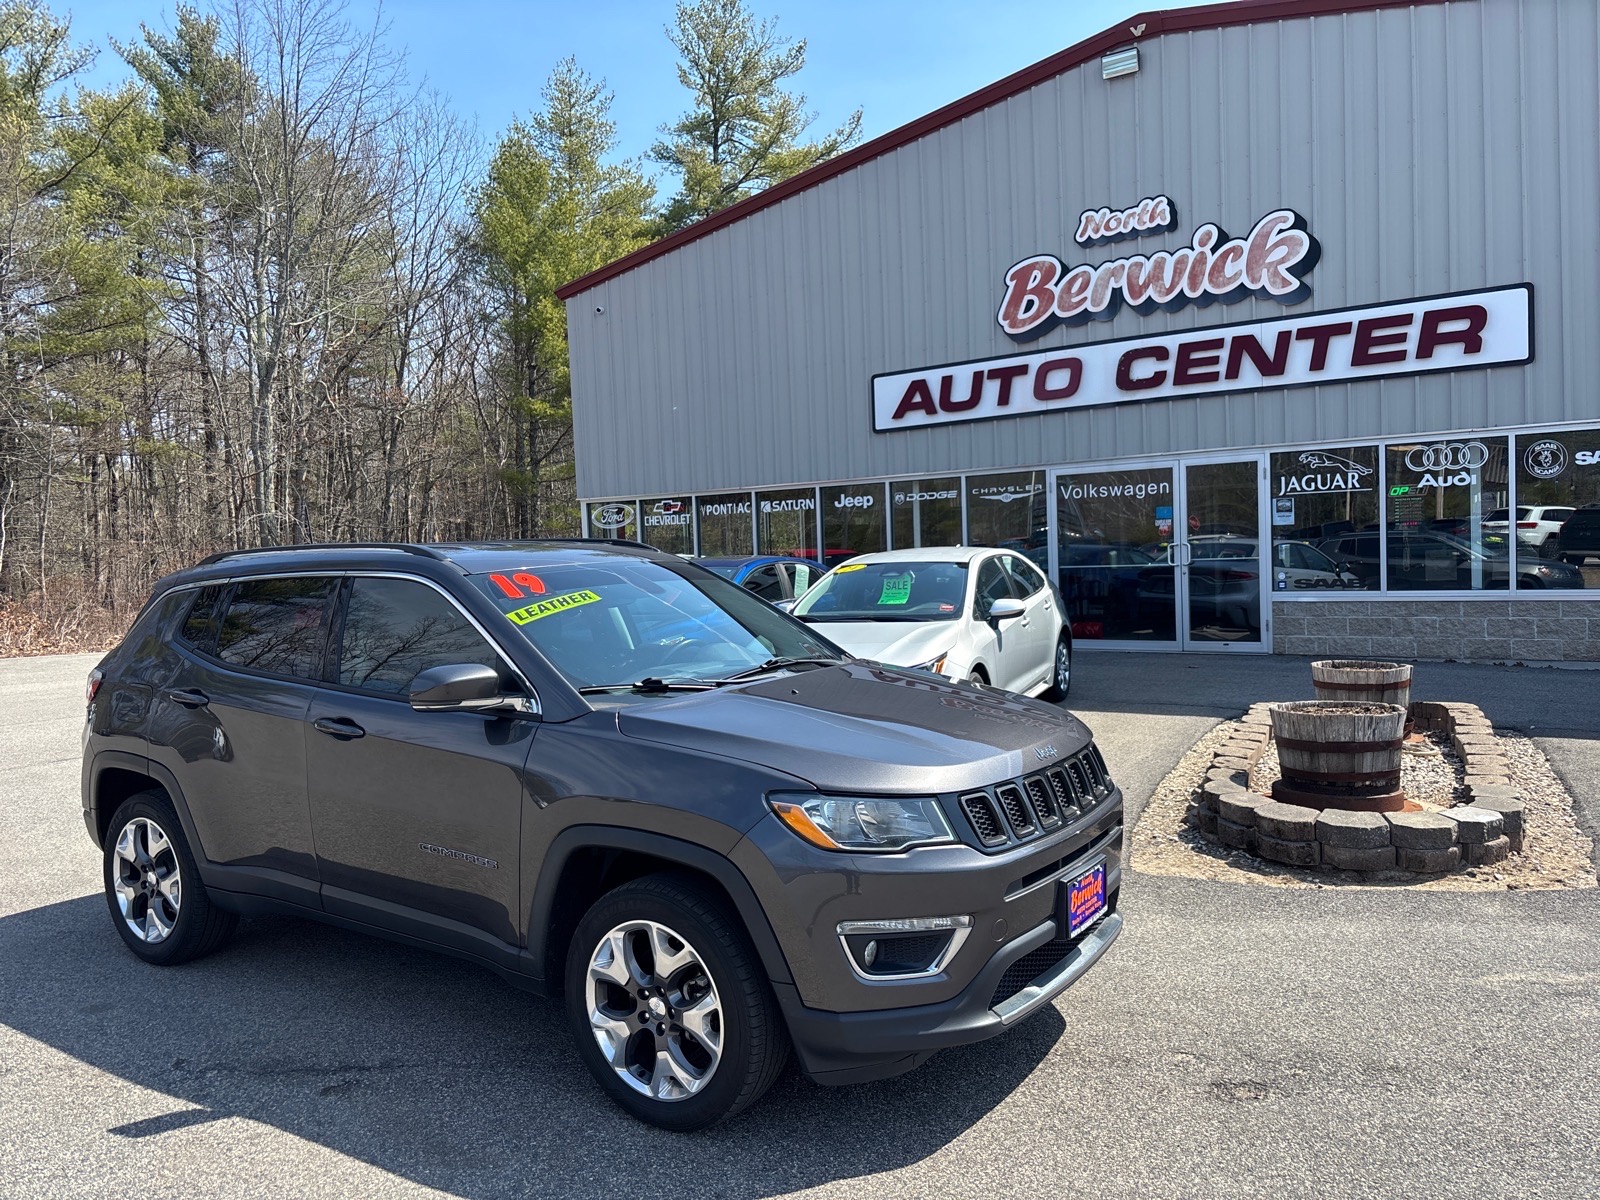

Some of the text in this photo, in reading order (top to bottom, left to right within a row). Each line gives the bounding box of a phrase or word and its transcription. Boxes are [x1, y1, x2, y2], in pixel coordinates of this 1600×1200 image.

[1074, 195, 1174, 244] North
[997, 206, 1315, 337] Berwick
[891, 303, 1489, 421] AUTO CENTER
[1534, 442, 1557, 452] SAAB
[1534, 465, 1560, 475] SCANIA
[1278, 472, 1361, 497] JAGUAR
[1417, 471, 1477, 488] Audi
[905, 490, 959, 501] DODGE
[972, 483, 1044, 495] CHRYSLER
[1060, 482, 1170, 499] Volkswagen
[706, 501, 751, 516] PONTIAC
[771, 498, 815, 512] SATURN
[834, 493, 874, 509] Jeep
[601, 507, 625, 525] Ford
[644, 513, 691, 527] CHEVROLET
[489, 572, 546, 599] 19
[885, 580, 908, 591] SALE
[514, 592, 593, 621] LEATHER
[418, 842, 499, 870] COMPASS
[1070, 873, 1102, 914] Berwick
